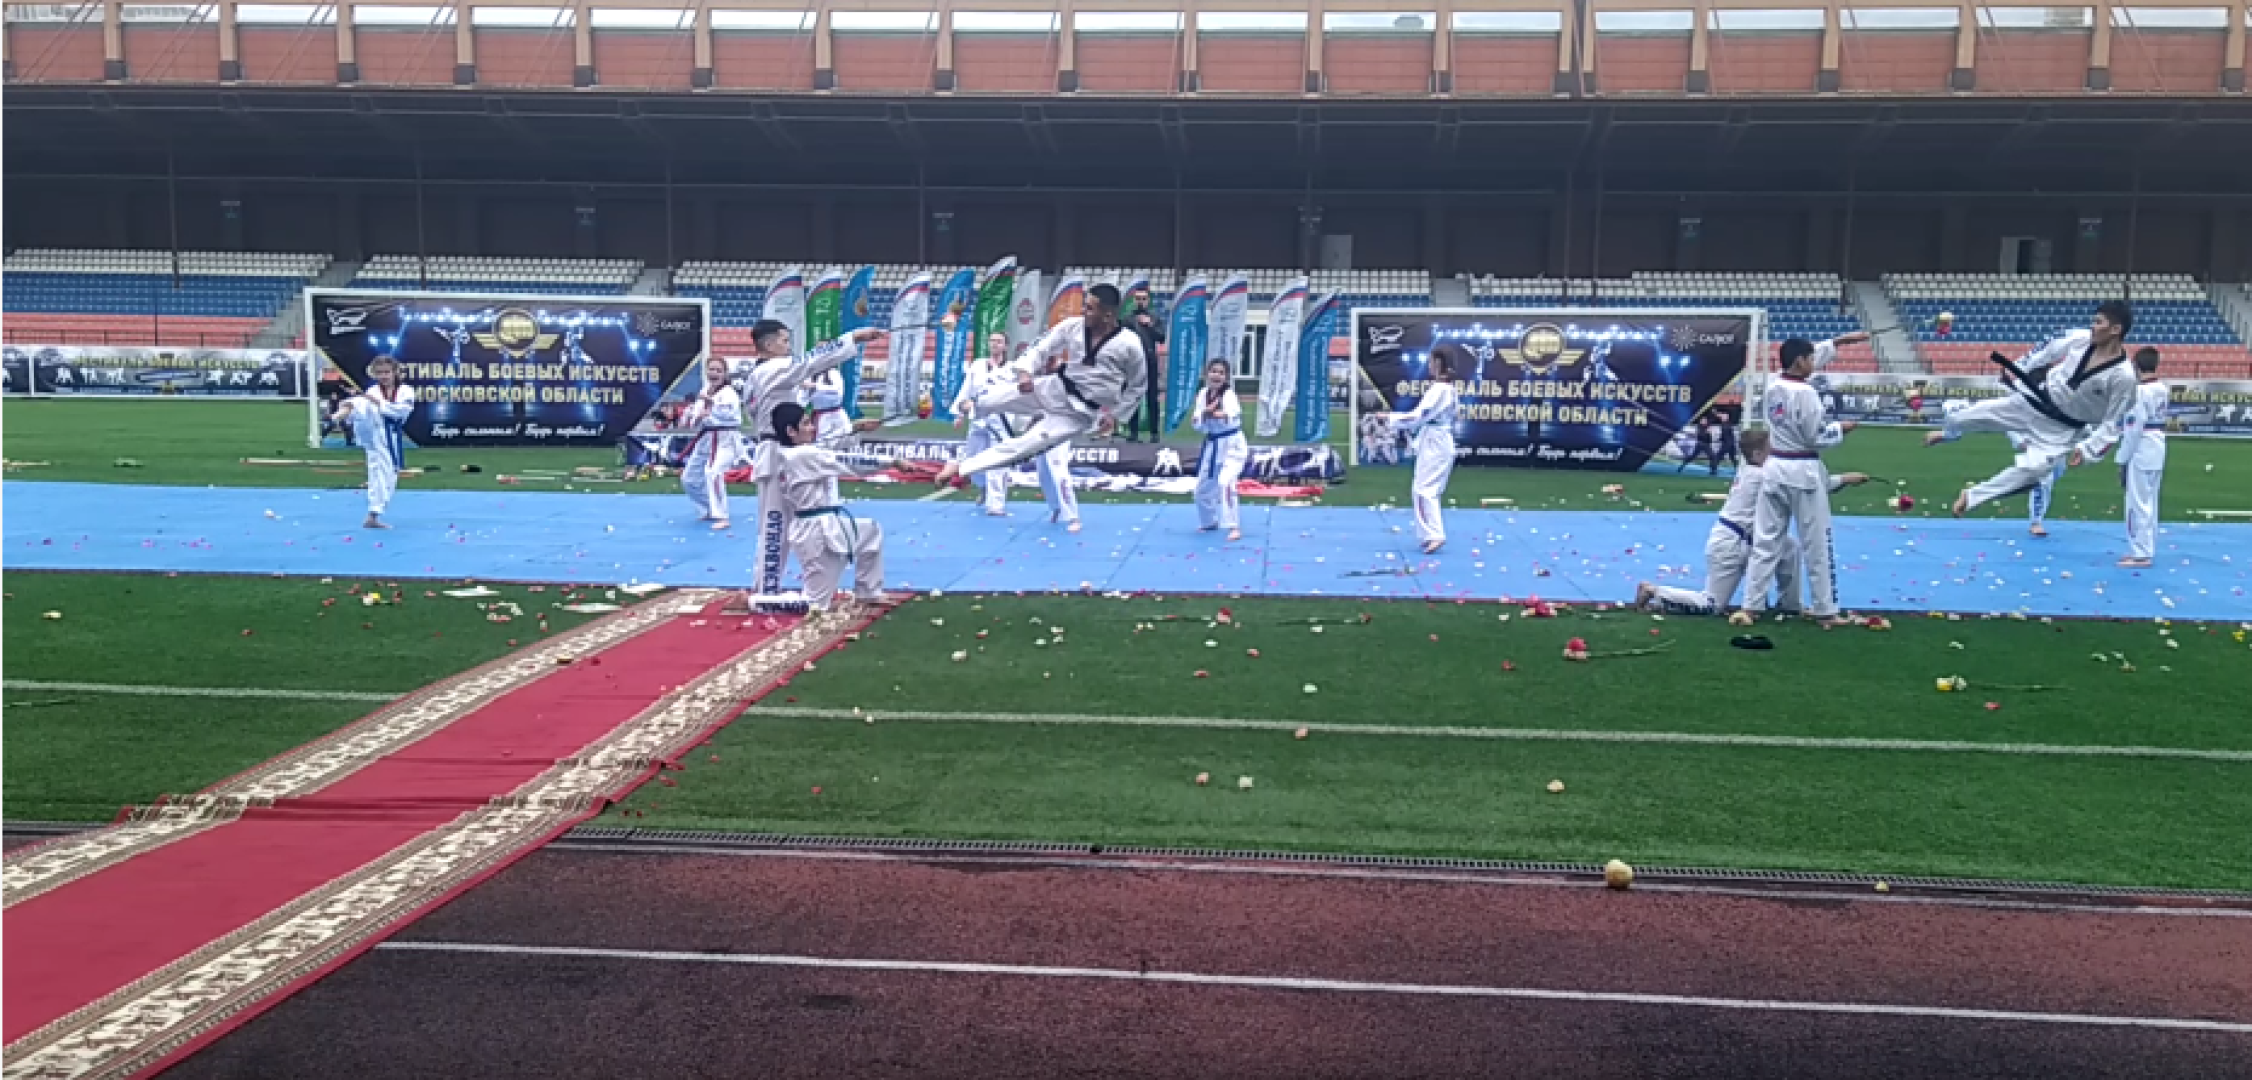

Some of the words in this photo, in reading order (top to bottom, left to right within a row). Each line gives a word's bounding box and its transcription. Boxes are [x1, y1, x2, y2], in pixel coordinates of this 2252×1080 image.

[366, 362, 482, 379] СТИВАЛЬ
[489, 364, 563, 381] БОЕВЫХ
[571, 367, 660, 382] ИСКУССТВ
[542, 388, 624, 404] ОБЛАСТИ
[1396, 379, 1502, 397] ФЕСВАЛЬ
[1508, 380, 1584, 399] БОЕВЫХ
[1591, 385, 1691, 403] ИСКУССТВ
[1457, 402, 1552, 421] СКОВСКОЙ
[1559, 407, 1648, 425] ОБЛАСТИ
[1068, 448, 1119, 462] УССТВ
